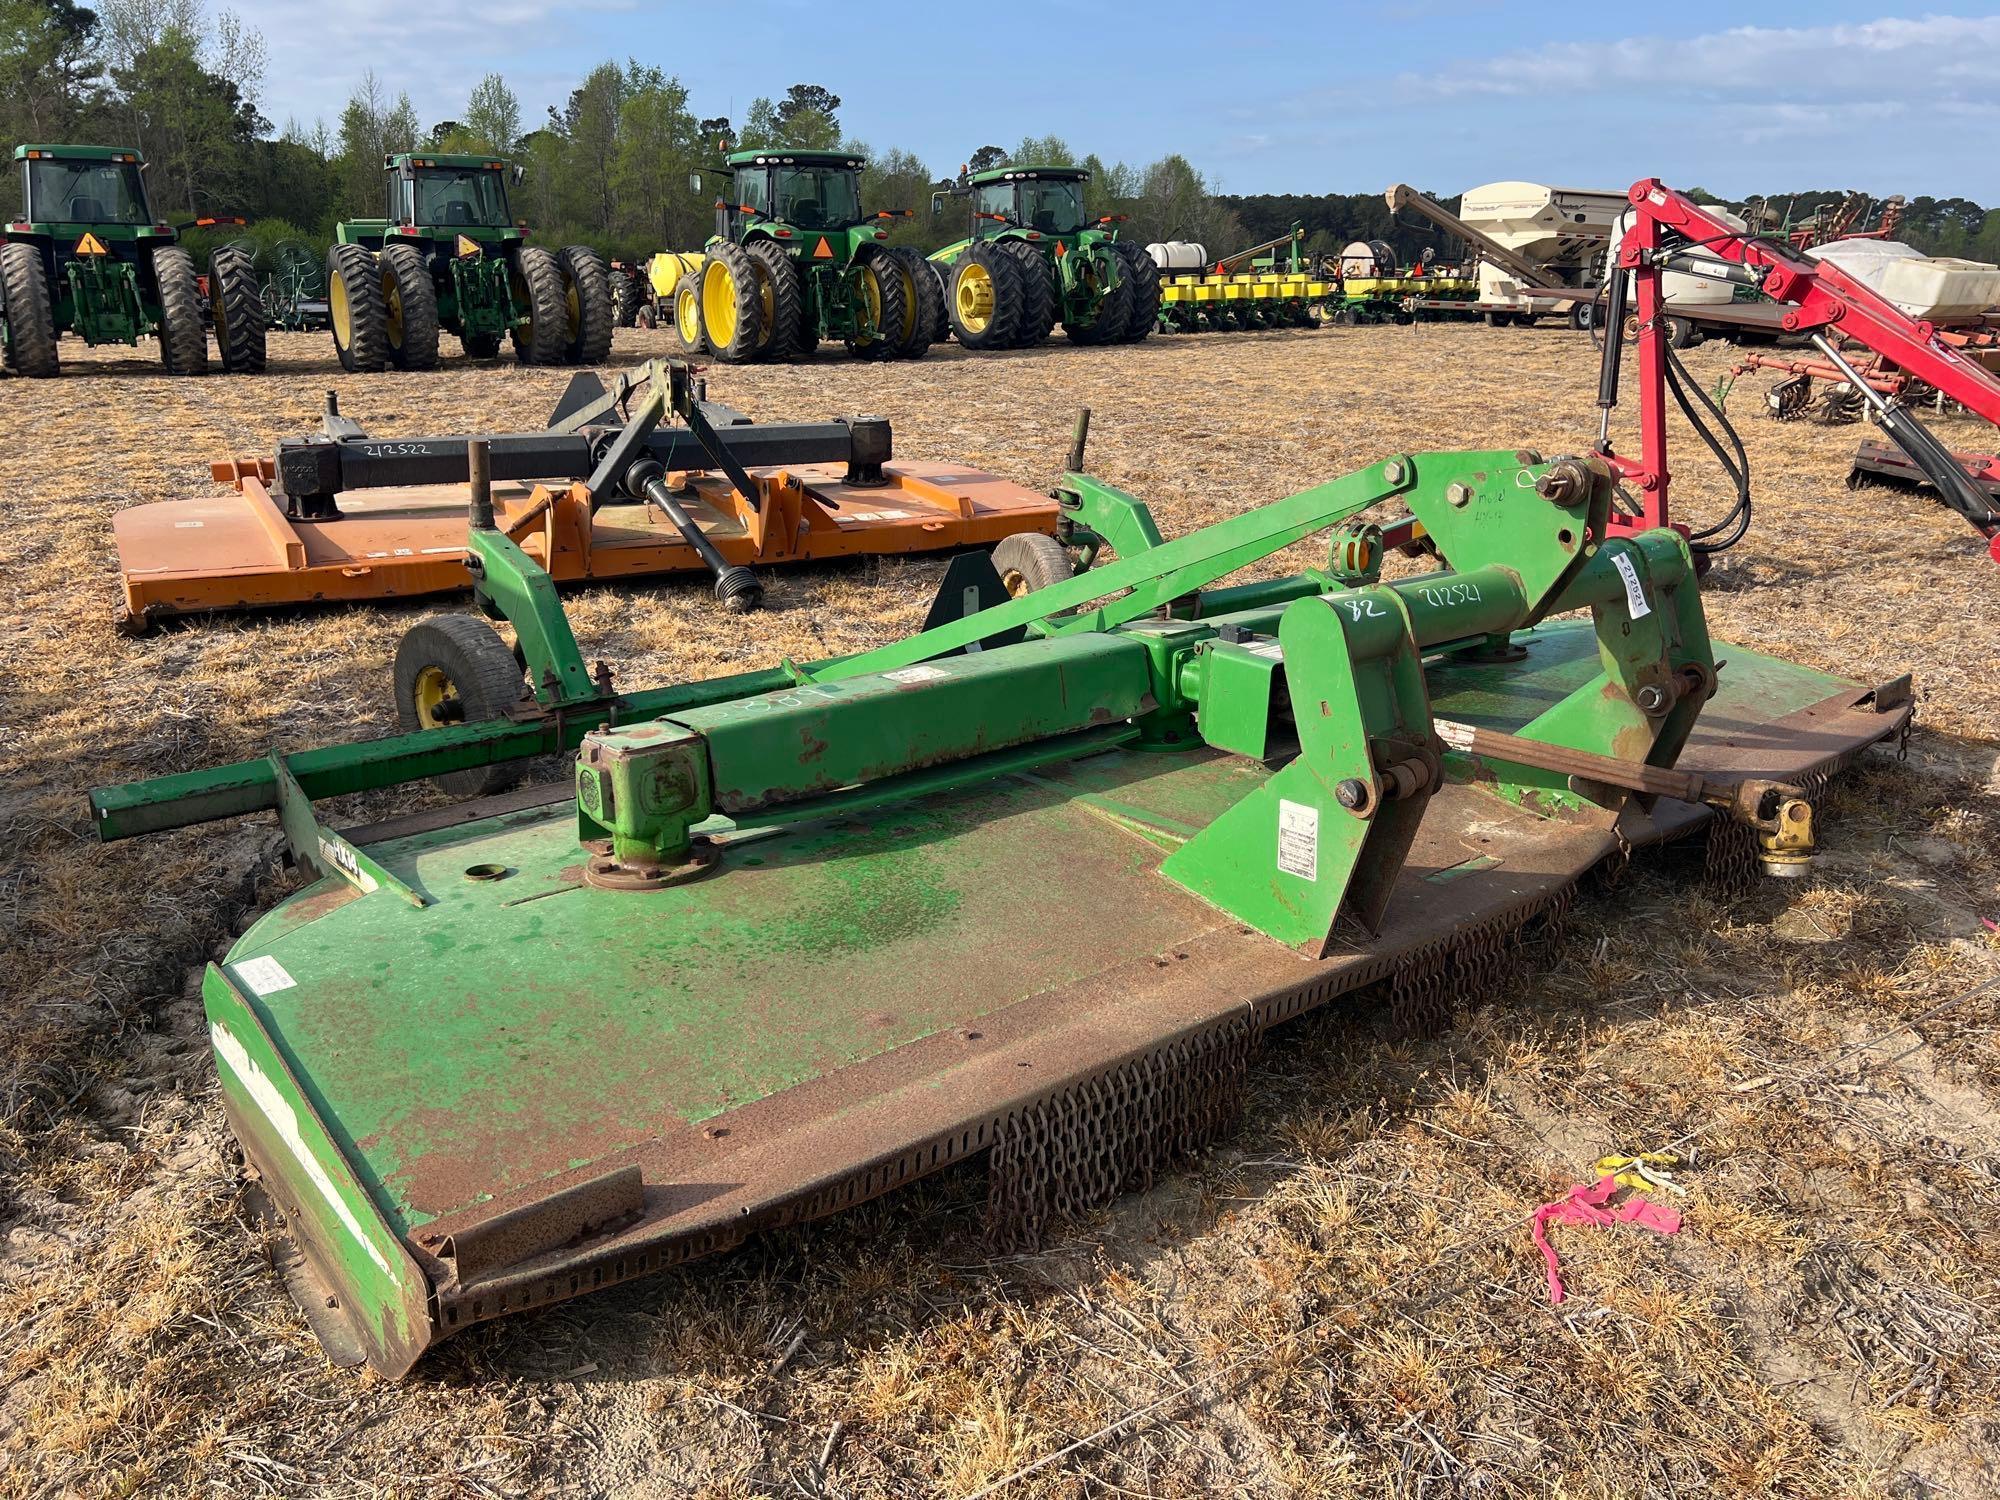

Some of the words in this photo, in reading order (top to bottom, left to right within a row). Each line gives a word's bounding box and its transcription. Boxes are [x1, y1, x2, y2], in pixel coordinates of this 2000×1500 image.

[364, 444, 432, 457] 212522
[1418, 583, 1482, 607] 212521
[1623, 565, 1644, 607] 212521
[1344, 599, 1387, 622] 82
